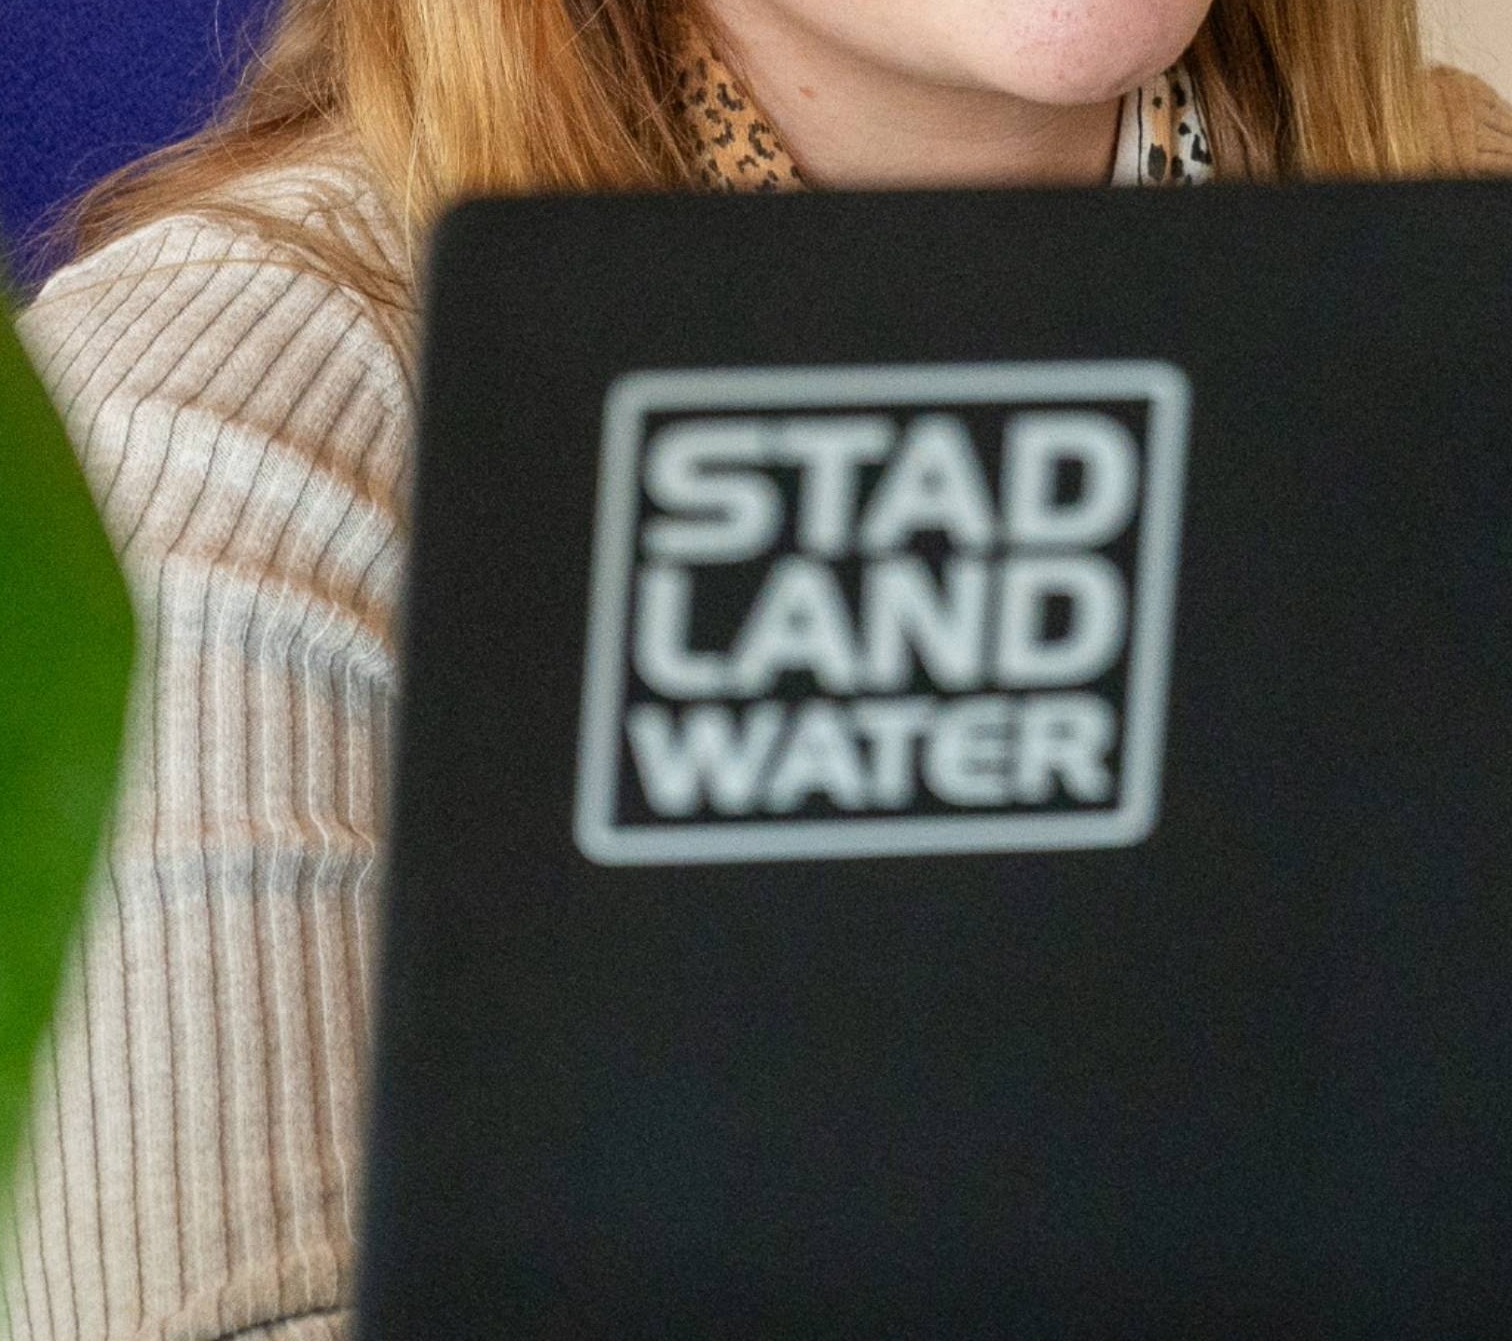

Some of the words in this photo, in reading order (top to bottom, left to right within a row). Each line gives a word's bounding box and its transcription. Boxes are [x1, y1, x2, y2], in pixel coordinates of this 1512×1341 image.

[642, 413, 1140, 563] STAD
[632, 550, 1128, 701] LAND
[625, 692, 1117, 817] WATER
